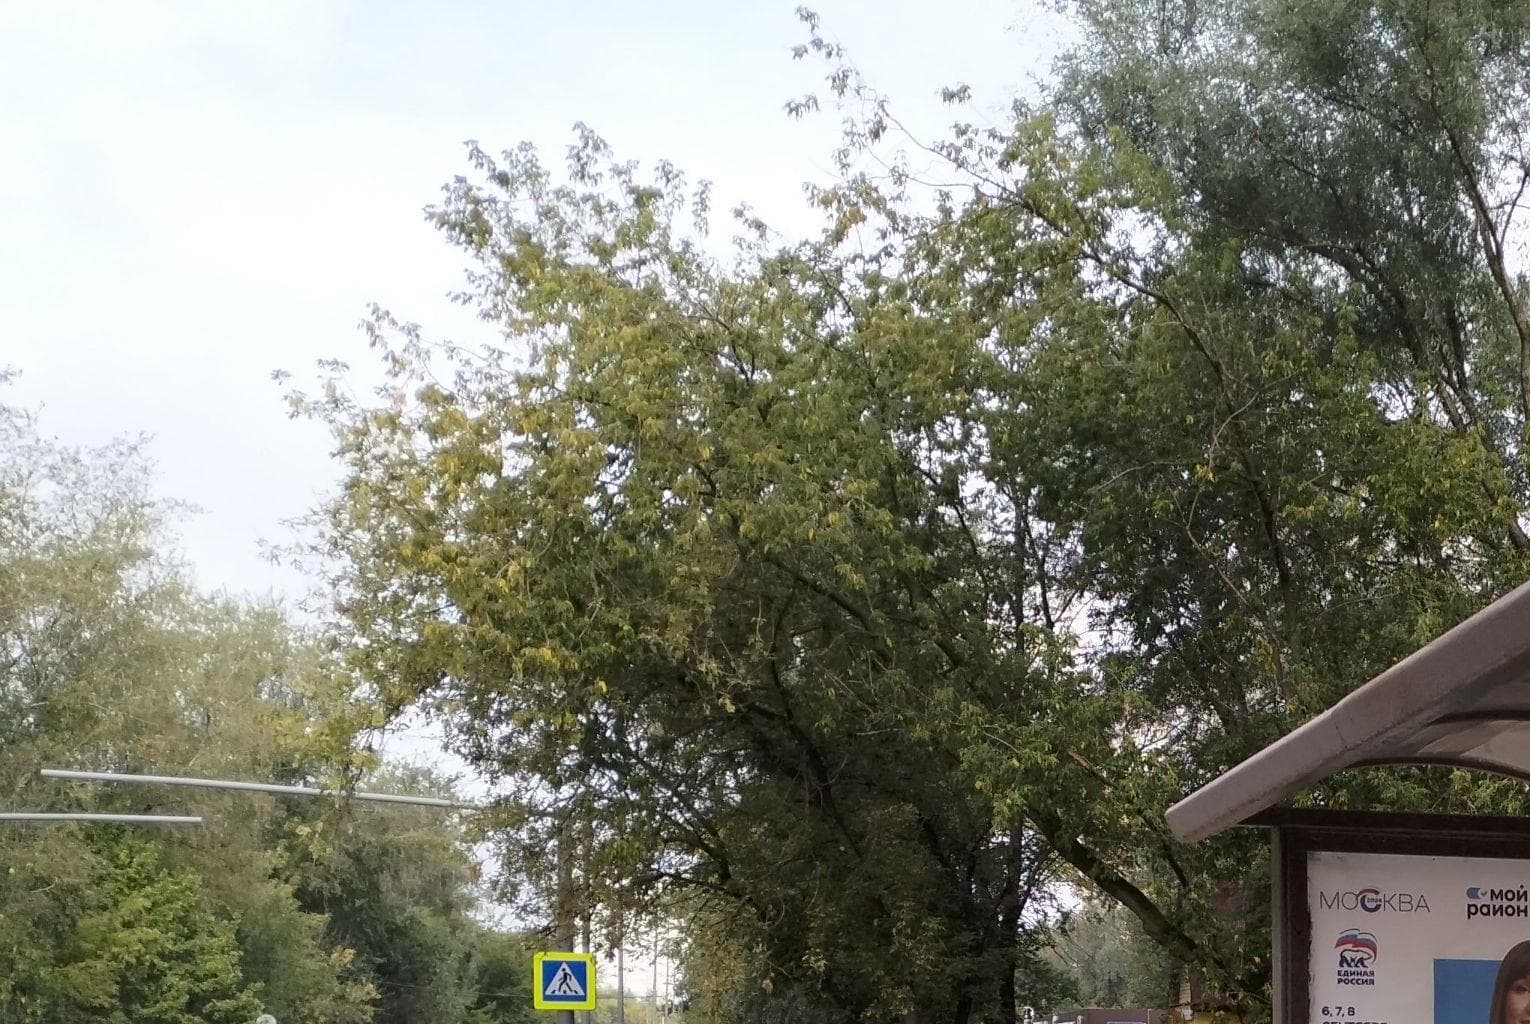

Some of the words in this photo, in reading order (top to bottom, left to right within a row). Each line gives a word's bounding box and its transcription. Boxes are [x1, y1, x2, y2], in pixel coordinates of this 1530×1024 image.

[1319, 888, 1431, 913] МОСКВА
[1337, 978, 1375, 986] РОССИЯ
[1321, 1006, 1333, 1017] 6,
[1335, 1006, 1345, 1017] 7,
[1347, 1006, 1355, 1016] 8
